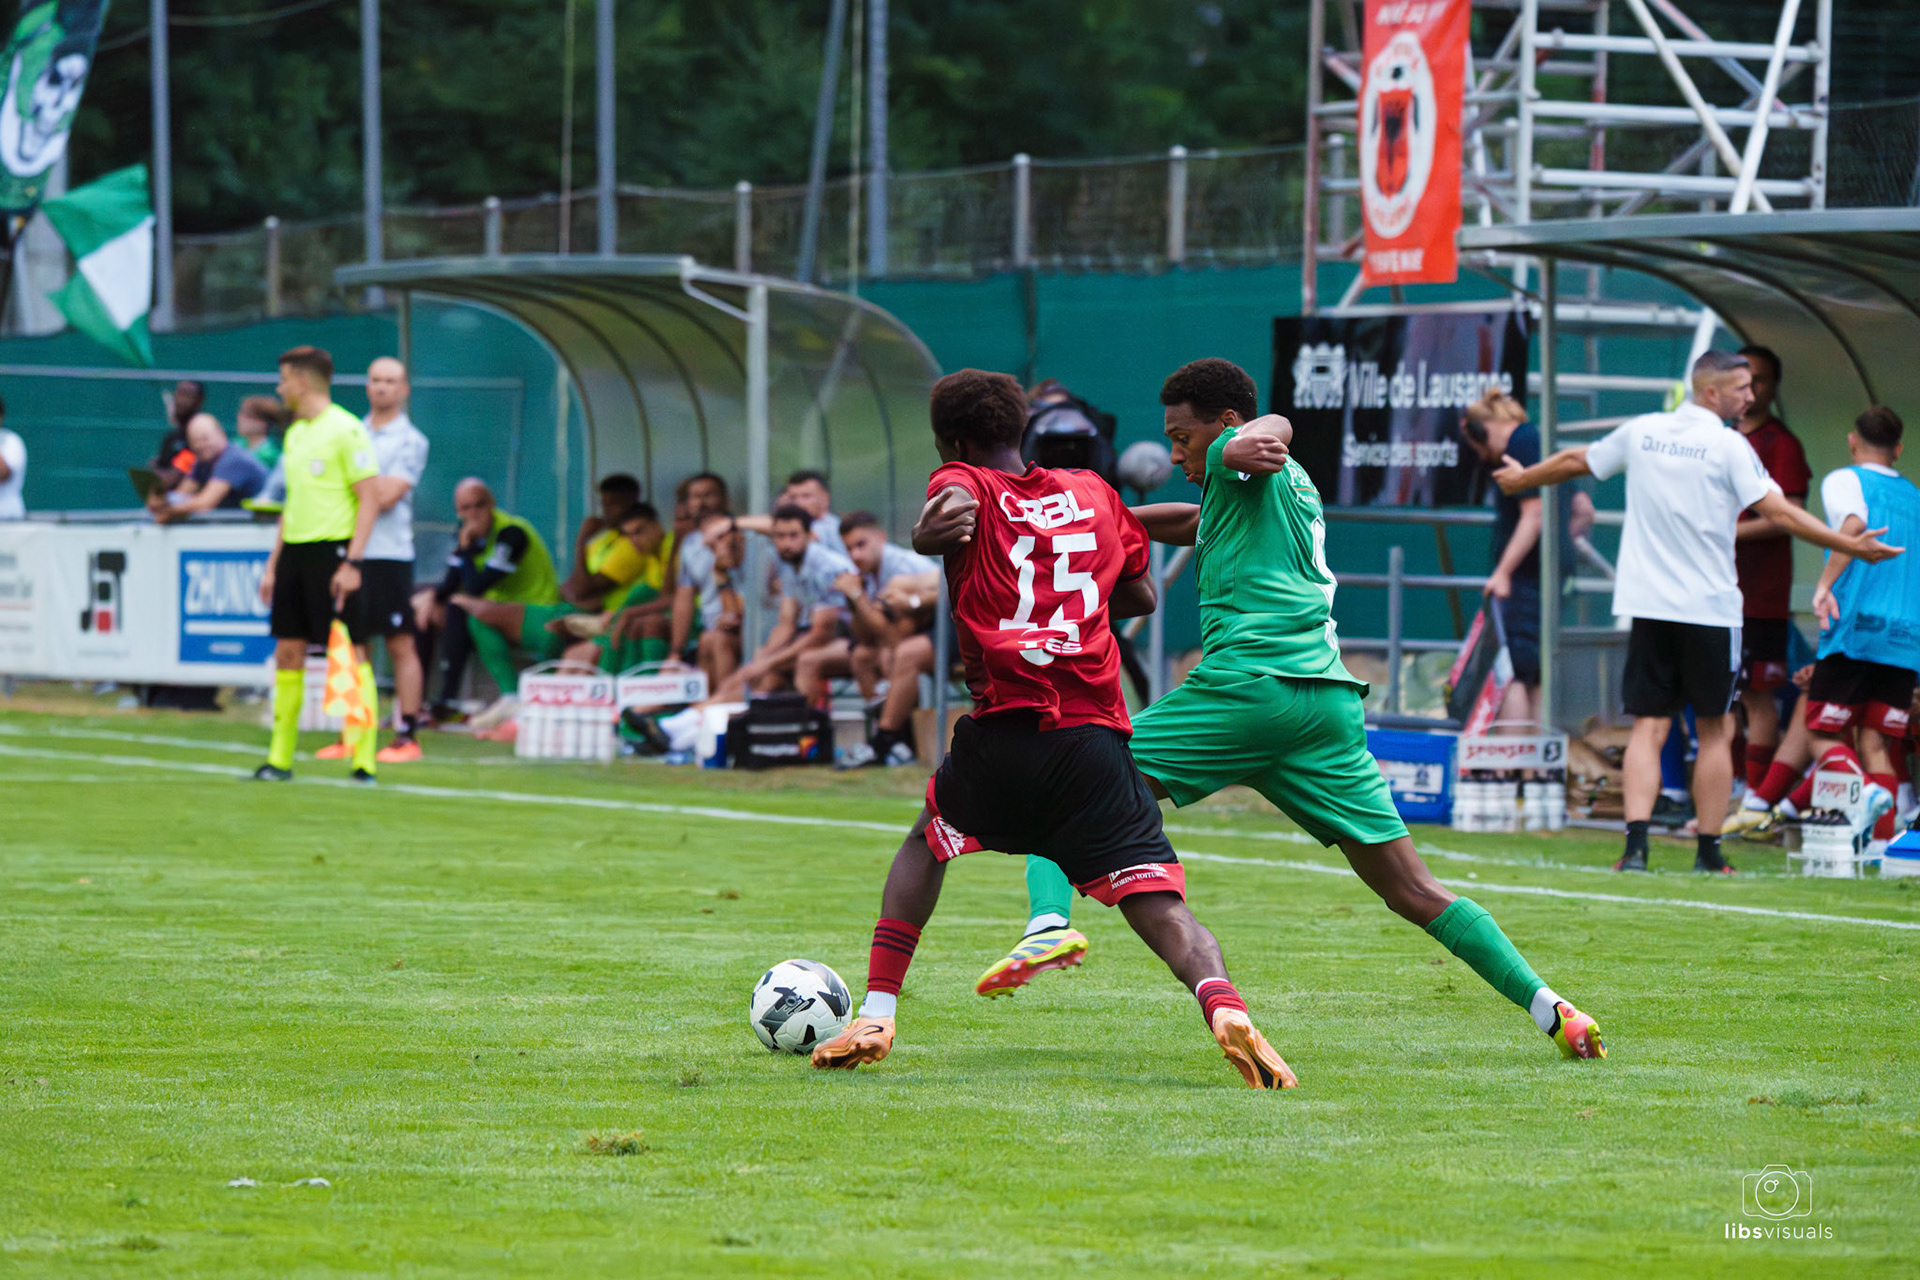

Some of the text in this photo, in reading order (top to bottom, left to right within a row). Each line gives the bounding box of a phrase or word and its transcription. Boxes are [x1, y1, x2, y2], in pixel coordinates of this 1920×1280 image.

[1350, 361, 1388, 408] Ville
[1390, 360, 1416, 409] de
[999, 532, 1100, 632] 15
[1111, 875, 1136, 890] MORINA
